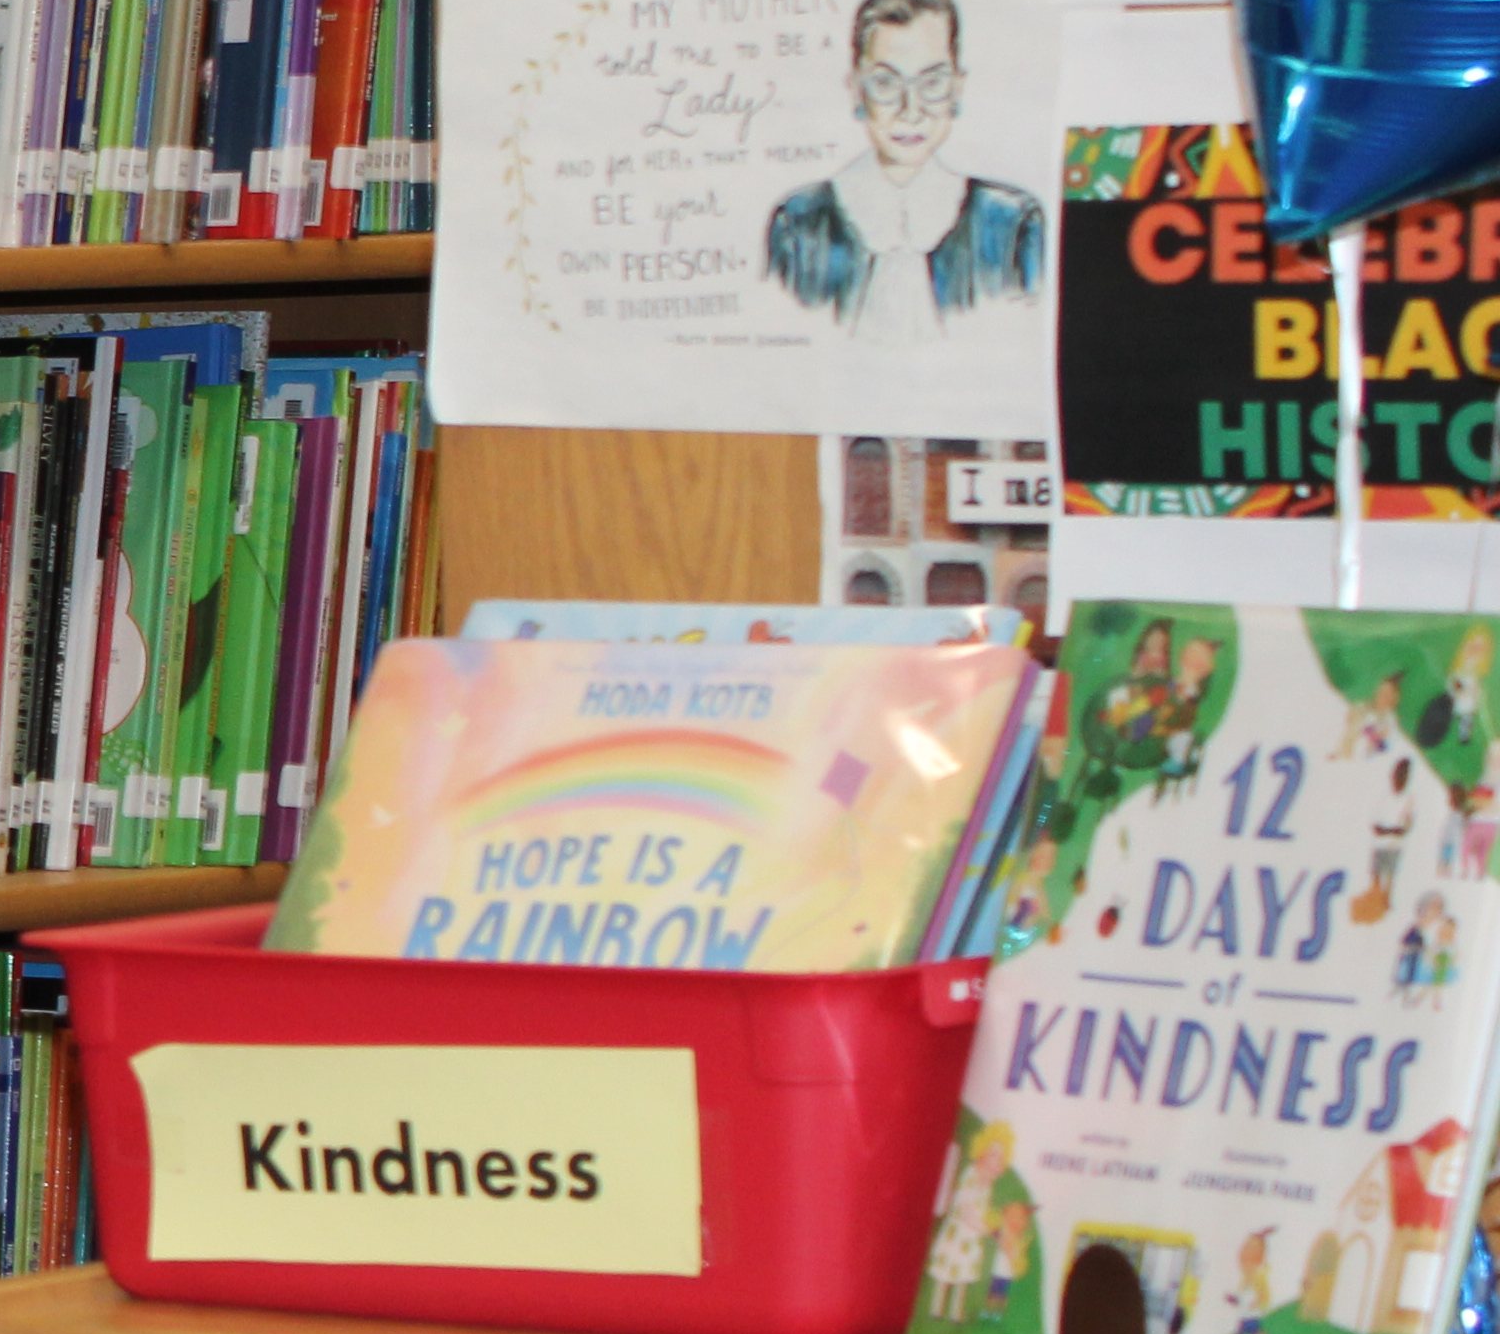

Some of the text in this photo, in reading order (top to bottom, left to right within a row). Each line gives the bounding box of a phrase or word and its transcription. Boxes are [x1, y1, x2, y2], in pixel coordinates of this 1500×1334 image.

[578, 682, 775, 720] HODA KOTB
[1222, 743, 1305, 841] 12
[475, 834, 744, 897] HOPE IS A
[402, 896, 775, 972] RAINBOW
[1140, 859, 1347, 963] DAYS
[1203, 971, 1243, 1007] of
[1004, 1001, 1420, 1135] KINDNESS
[237, 1119, 602, 1202] Kindness
